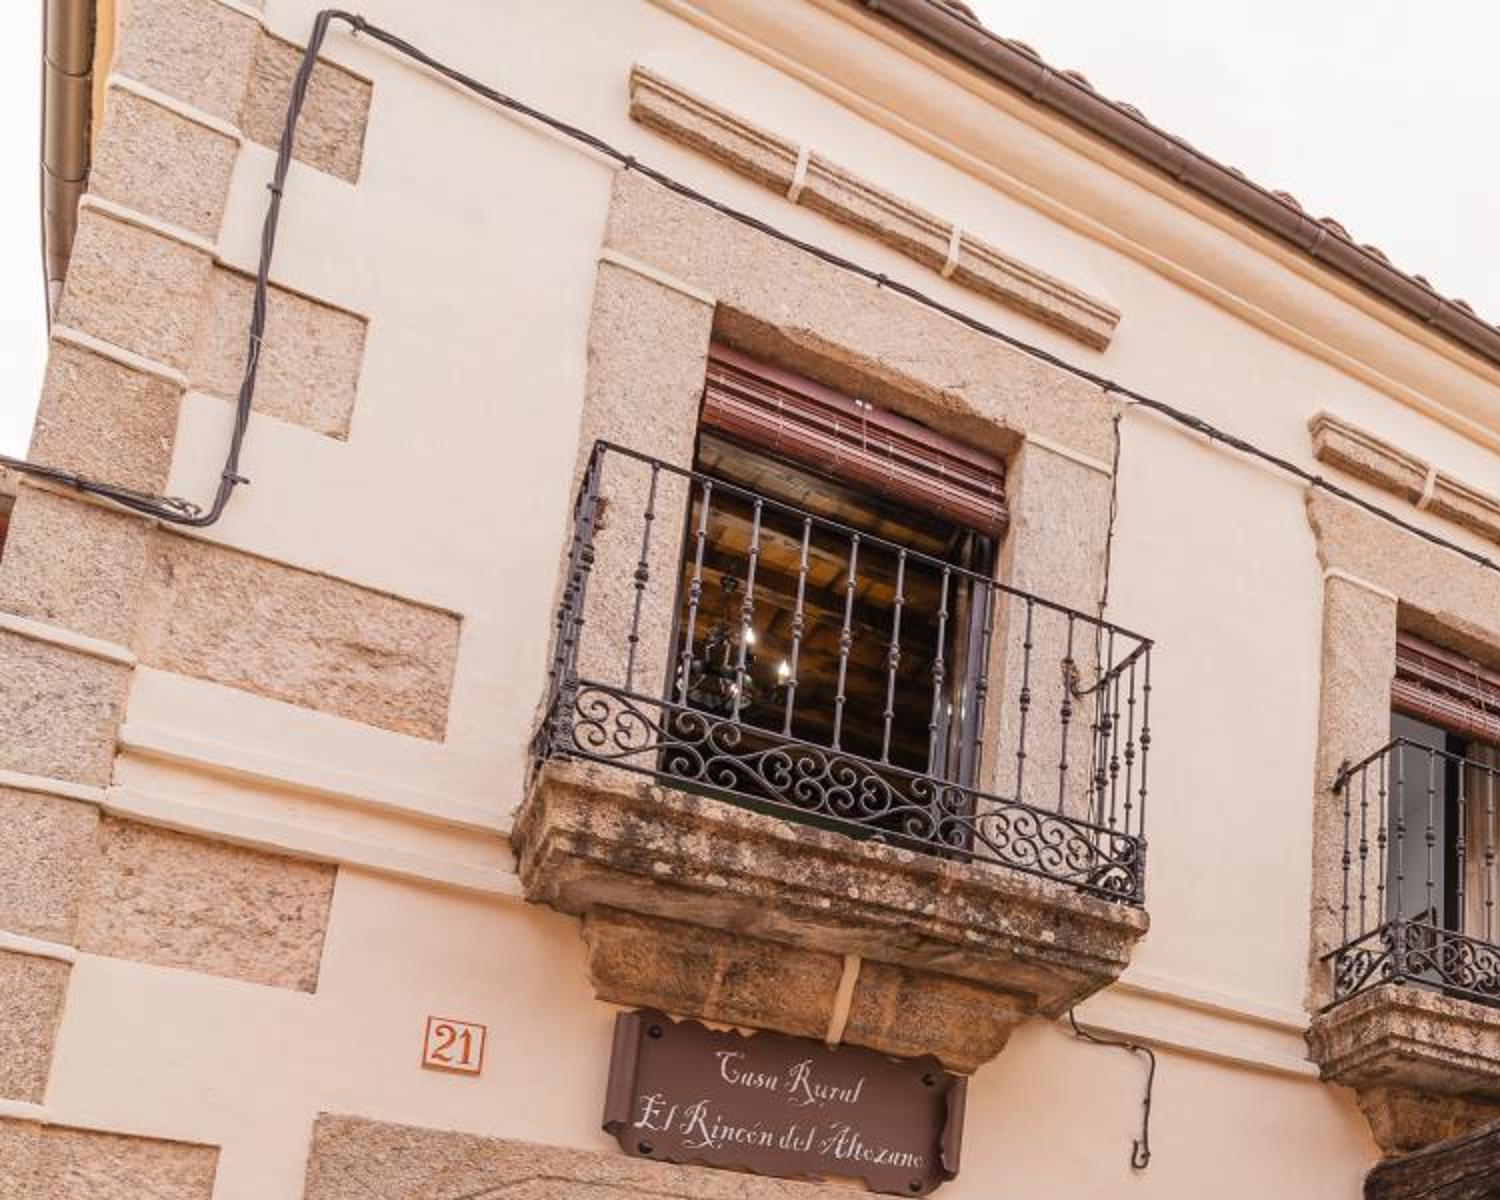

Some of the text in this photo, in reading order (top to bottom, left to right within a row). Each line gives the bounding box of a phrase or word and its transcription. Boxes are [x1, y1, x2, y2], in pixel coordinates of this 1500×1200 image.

[431, 1024, 474, 1064] 21
[715, 1051, 866, 1107] Casa Rural
[633, 1092, 679, 1131] El
[680, 1099, 774, 1149] Rincón
[779, 1125, 816, 1151] del
